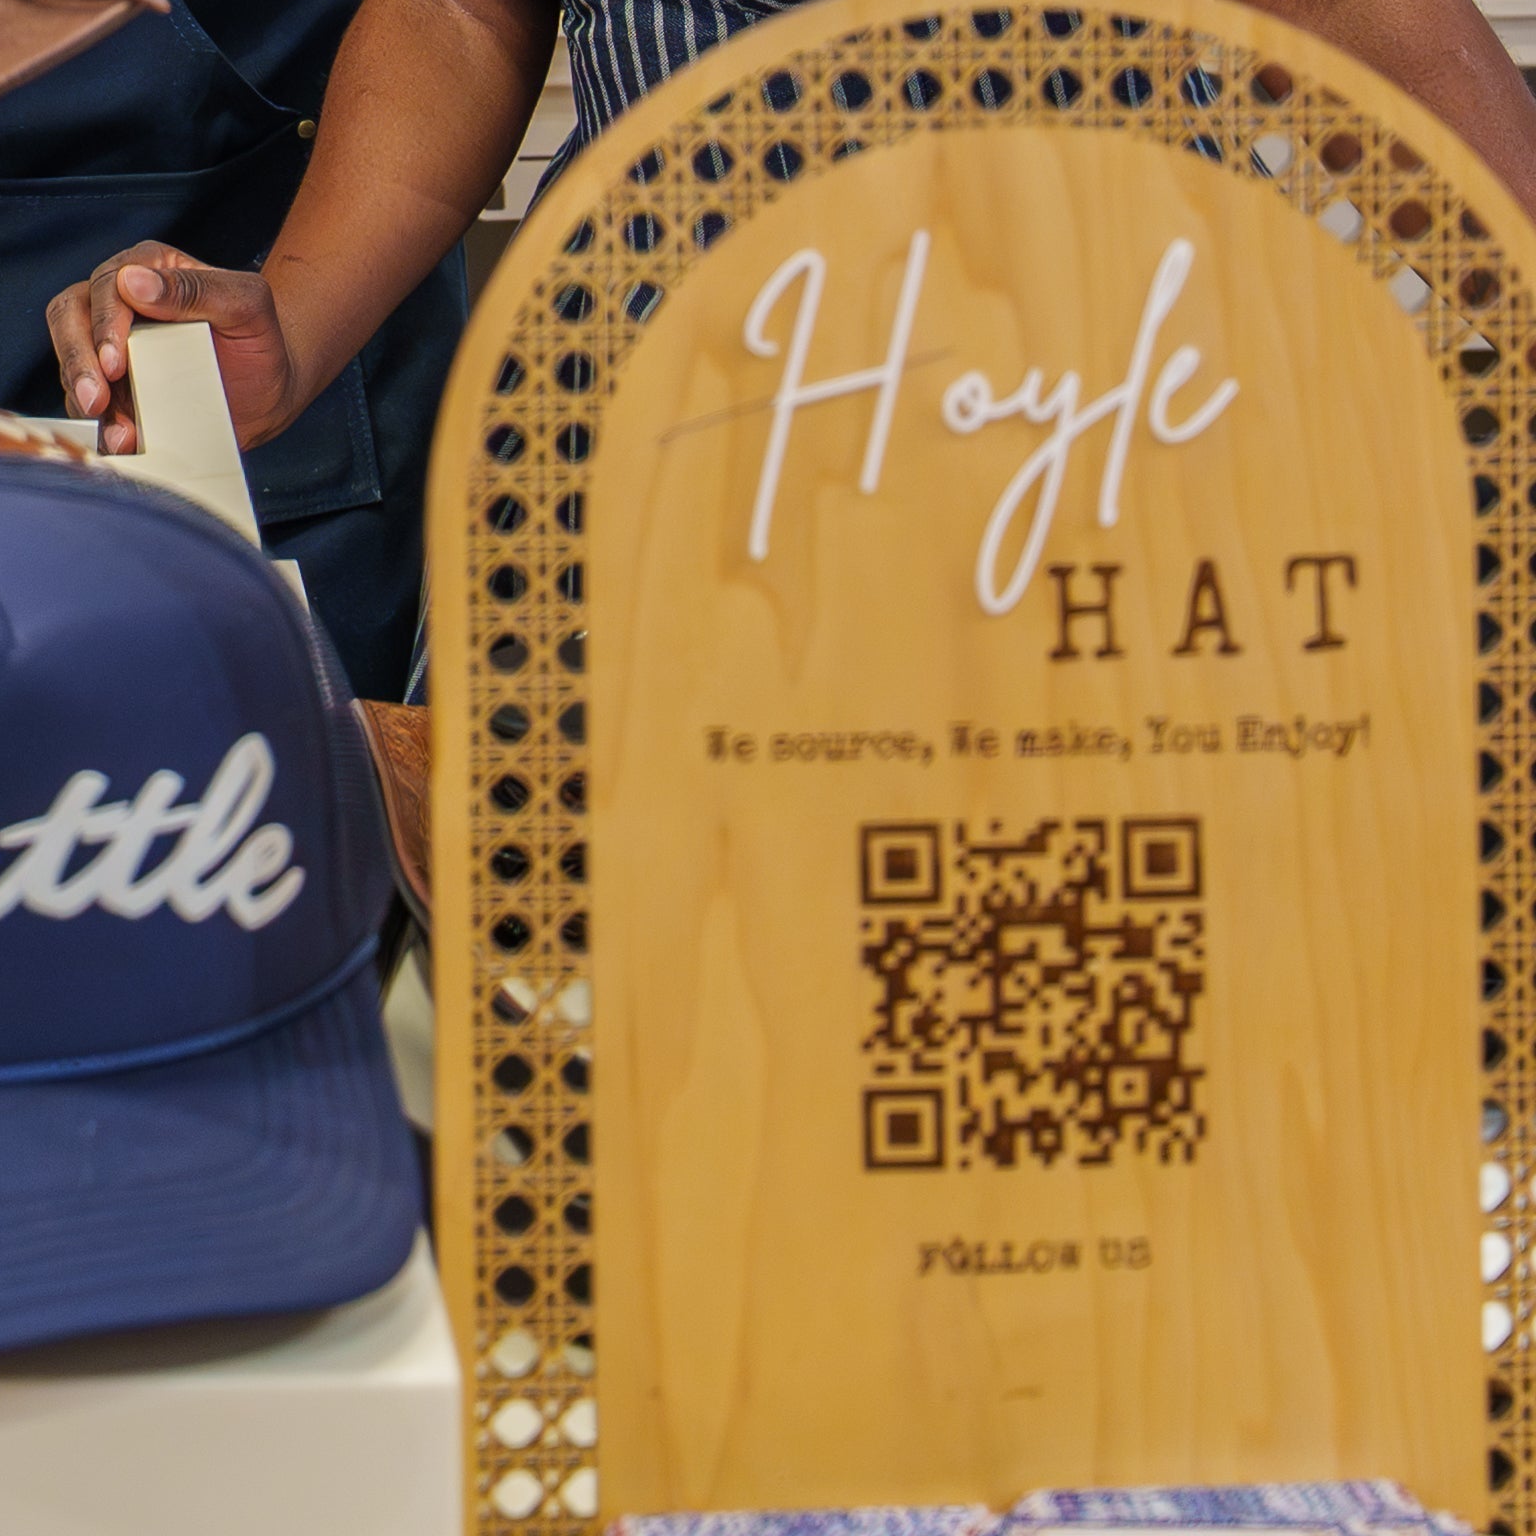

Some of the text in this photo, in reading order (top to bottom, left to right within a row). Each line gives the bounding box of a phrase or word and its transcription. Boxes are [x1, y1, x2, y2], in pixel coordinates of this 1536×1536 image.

[743, 229, 1240, 616] Hoyle
[1046, 553, 1360, 662] HAT
[1145, 714, 1222, 754] You
[1099, 1236, 1153, 1270] US
